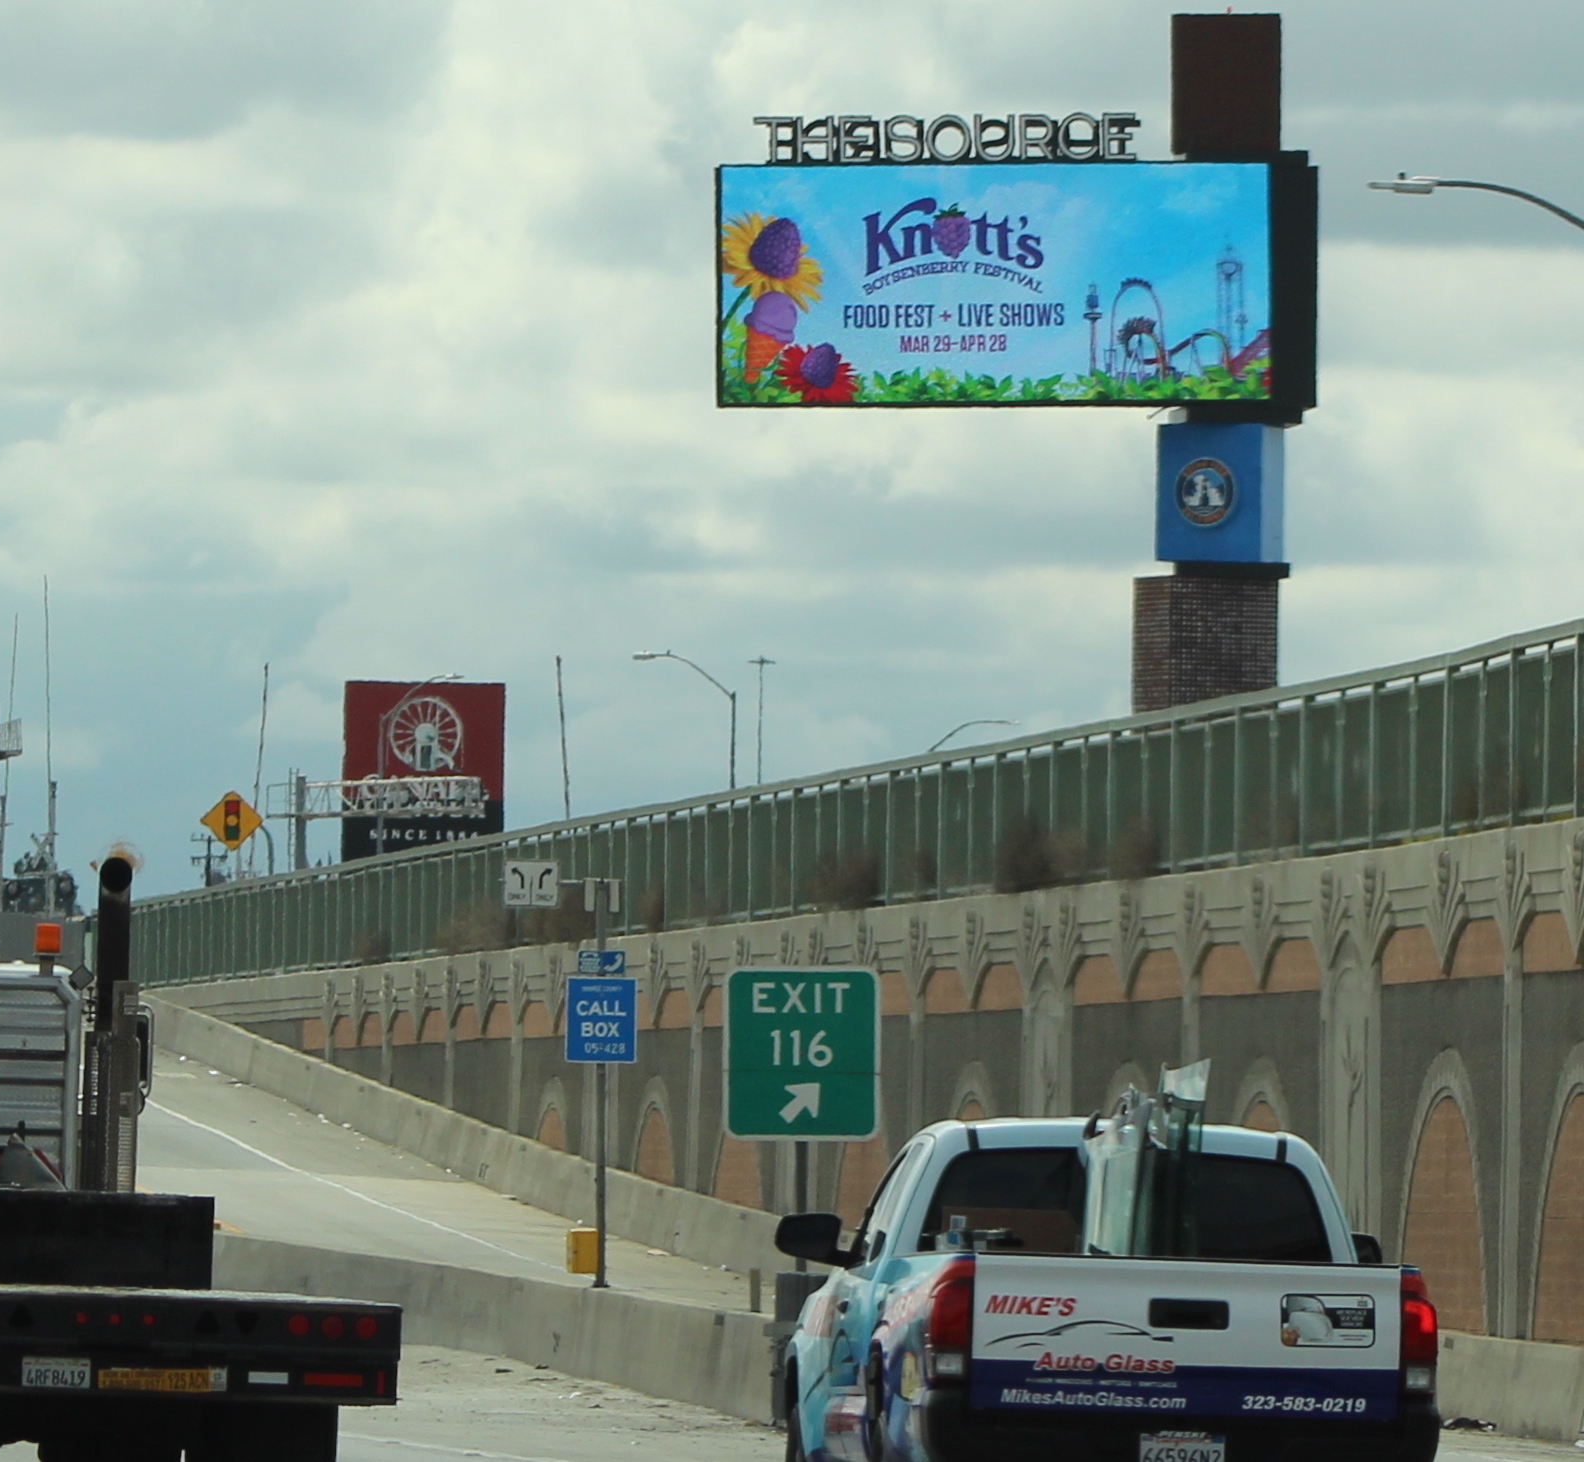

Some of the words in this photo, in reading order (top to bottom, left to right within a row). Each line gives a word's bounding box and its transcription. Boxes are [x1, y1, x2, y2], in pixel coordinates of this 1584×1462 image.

[753, 115, 872, 162] THE
[885, 112, 1139, 162] SOURCE
[862, 197, 1044, 276] Knott's
[862, 261, 969, 296] BOYSENBERRY
[973, 262, 1044, 294] FESTIVAL
[843, 304, 890, 328] FOOD
[894, 304, 934, 328] FEST
[957, 303, 994, 327] LIVE
[999, 303, 1065, 327] SHOWS
[900, 335, 930, 353] MAR
[989, 334, 1007, 352] 28
[369, 829, 428, 841] SINCE
[576, 1000, 627, 1017] CALL
[752, 982, 851, 1014] EXIT
[581, 1022, 620, 1038] BOX
[770, 1029, 833, 1068] 116
[984, 1295, 1077, 1317] MIKE'S
[1034, 1352, 1097, 1371] Auto
[1104, 1354, 1176, 1373] Glass
[25, 1368, 87, 1387] 4RF8419
[1001, 1388, 1187, 1409] MikesAutoGlass.com
[1242, 1395, 1367, 1413] 323-583-0219
